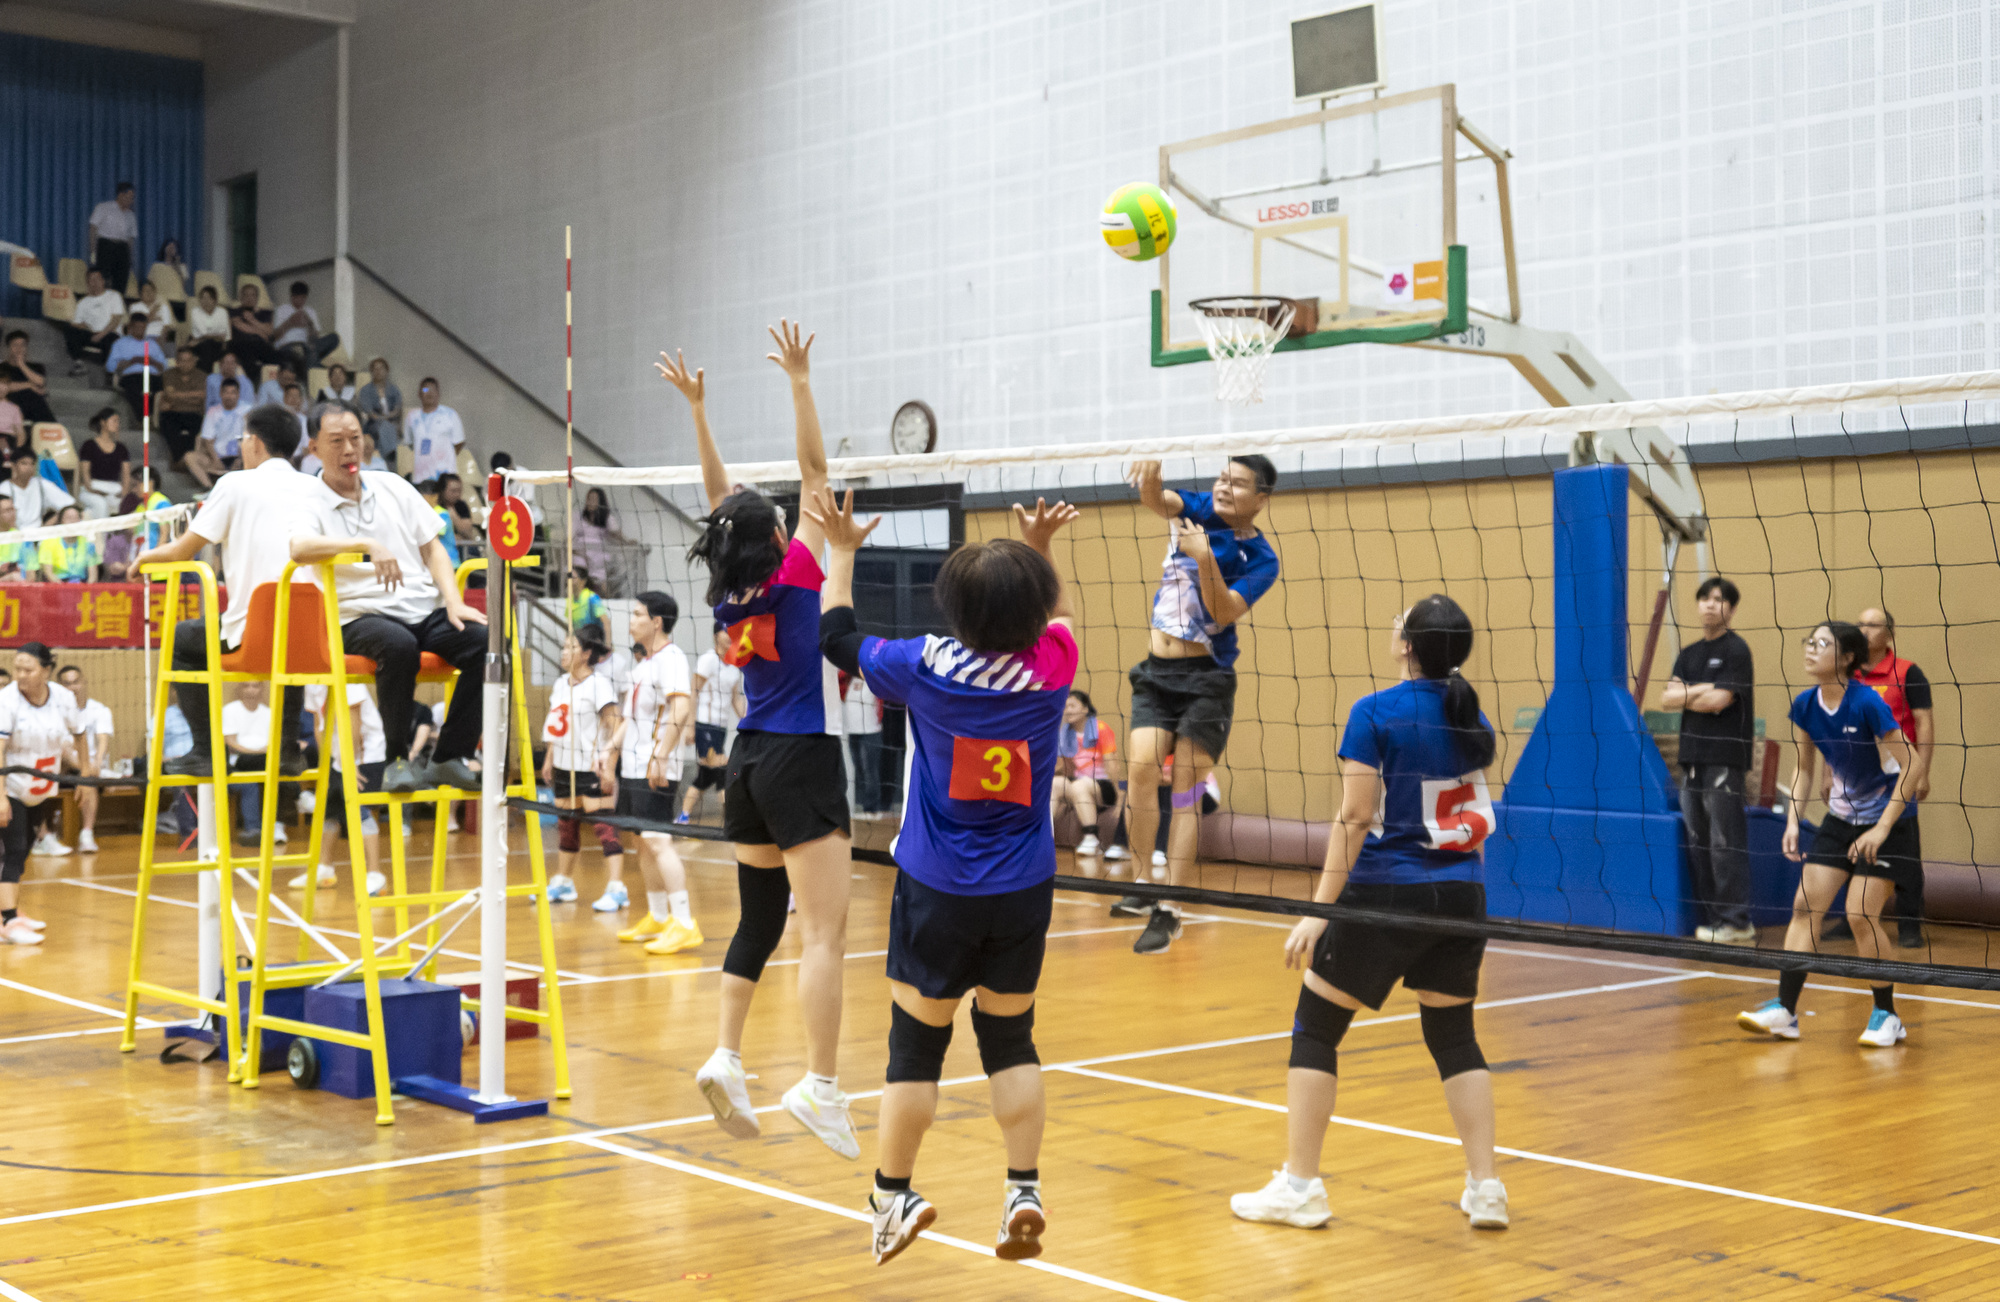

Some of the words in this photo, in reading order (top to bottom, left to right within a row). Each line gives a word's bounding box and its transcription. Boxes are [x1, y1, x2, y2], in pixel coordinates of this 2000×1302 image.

[1258, 202, 1310, 222] LESSO
[501, 510, 520, 547] 3
[546, 703, 569, 737] 3
[29, 756, 56, 796] 5
[980, 746, 1012, 792] 3
[1436, 782, 1489, 853] 5
